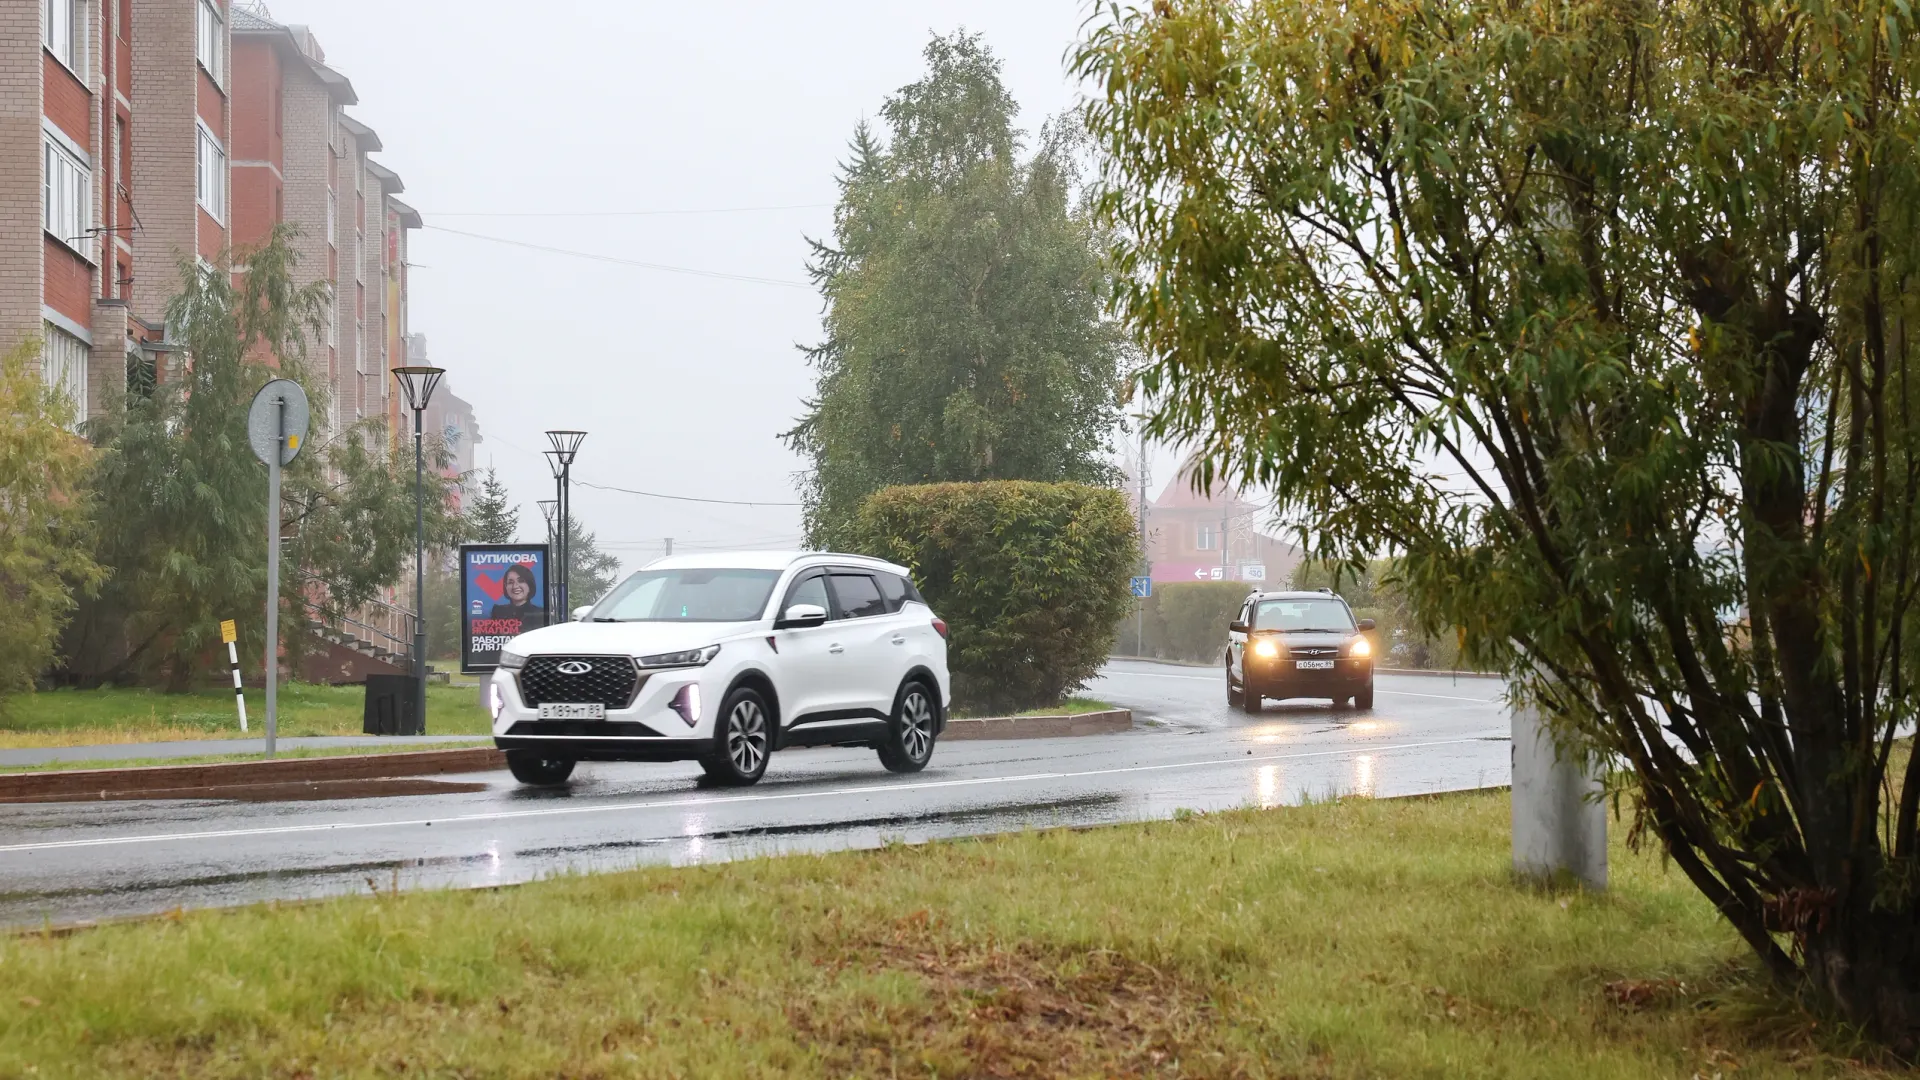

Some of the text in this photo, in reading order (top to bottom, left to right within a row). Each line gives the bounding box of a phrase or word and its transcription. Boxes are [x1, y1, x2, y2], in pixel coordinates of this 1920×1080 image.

[471, 553, 538, 565] ЦУПИКОВА
[472, 619, 523, 627] ГОРЖУСЬ
[472, 636, 517, 644] РАБОТА
[472, 643, 495, 653] ДЛЯ
